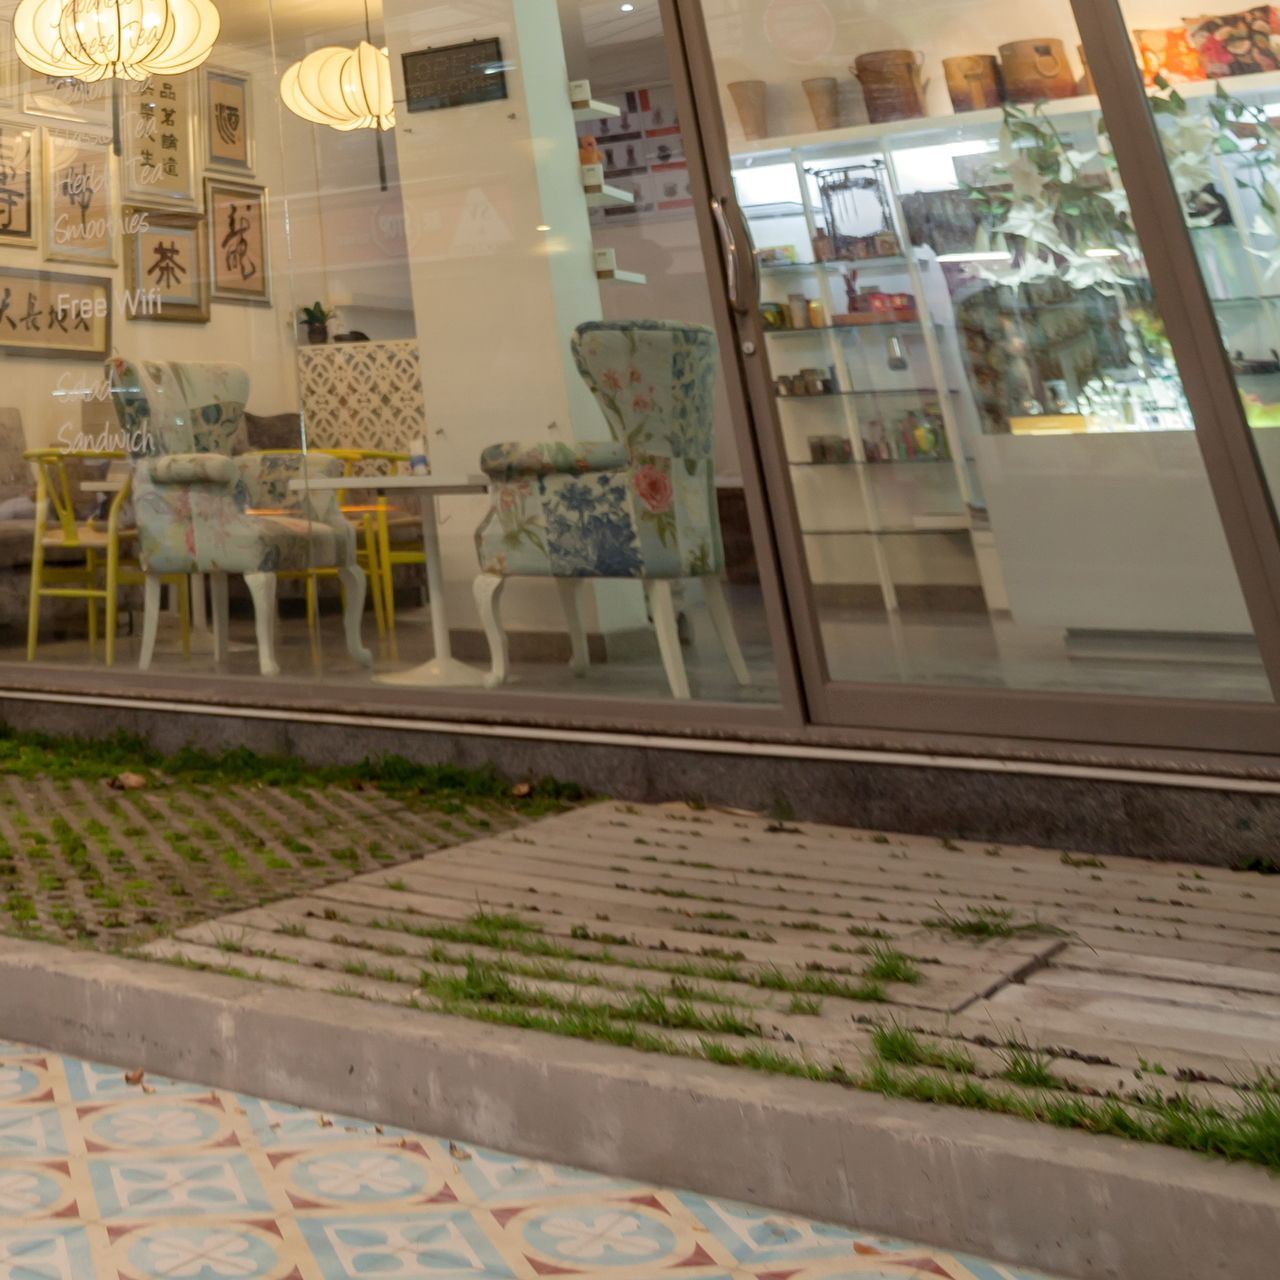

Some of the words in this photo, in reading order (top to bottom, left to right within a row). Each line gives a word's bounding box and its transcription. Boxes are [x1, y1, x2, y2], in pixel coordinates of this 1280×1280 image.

[122, 20, 160, 48] Tea
[121, 111, 159, 139] Tea
[125, 156, 165, 186] Tea
[146, 240, 187, 289] 茶
[56, 293, 108, 322] Free
[115, 287, 163, 318] Wifi
[56, 417, 156, 455] Sandwich
